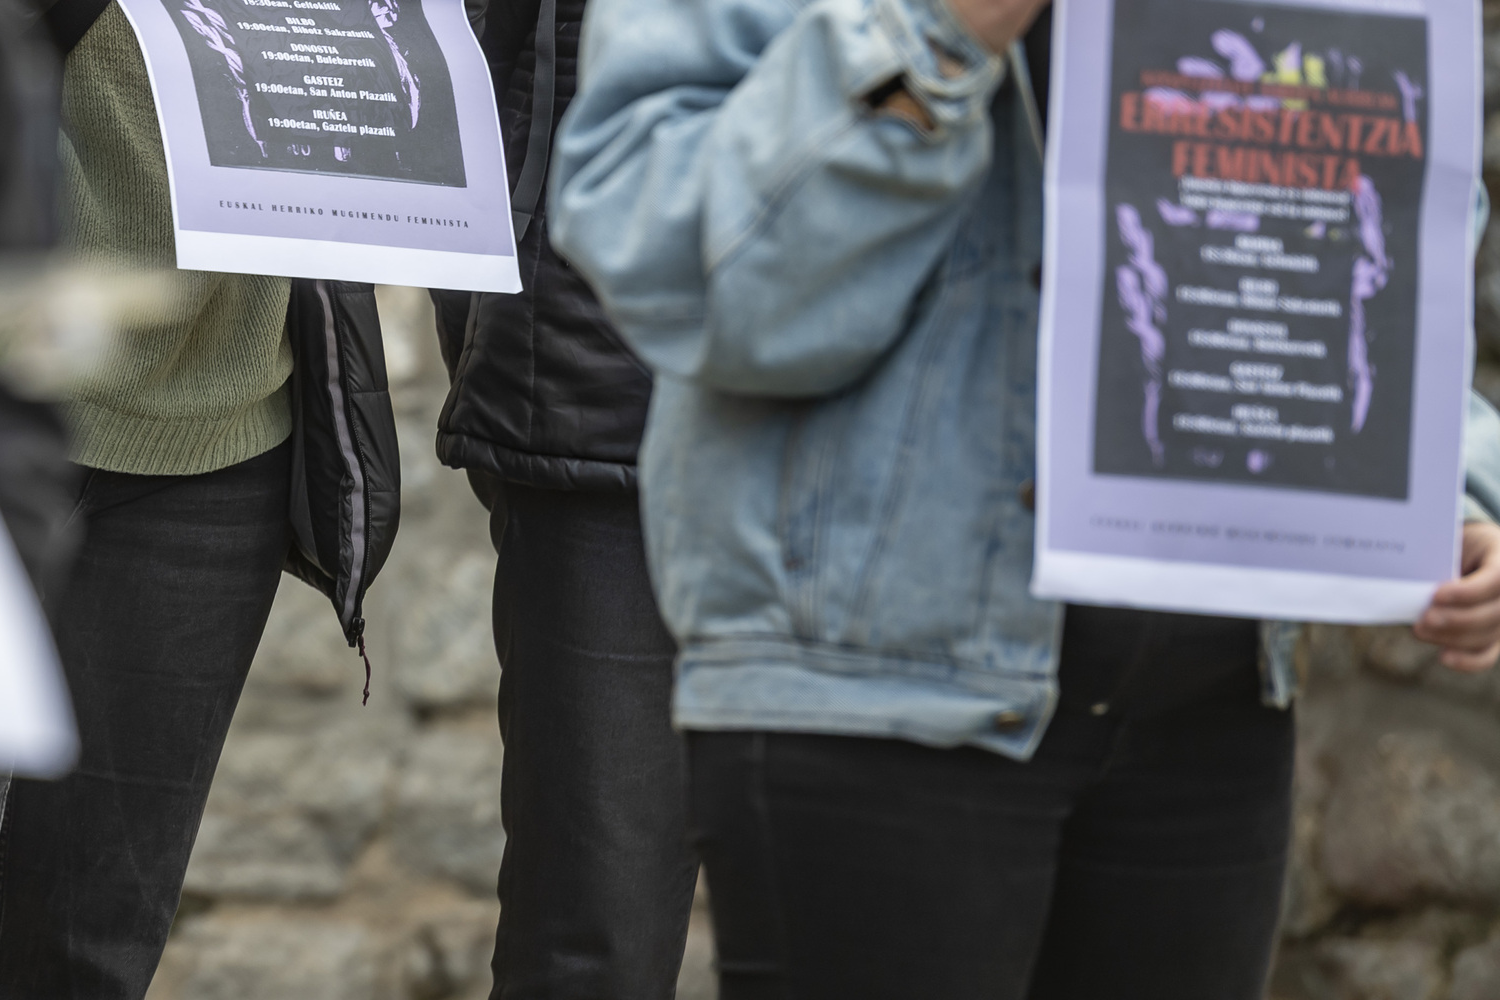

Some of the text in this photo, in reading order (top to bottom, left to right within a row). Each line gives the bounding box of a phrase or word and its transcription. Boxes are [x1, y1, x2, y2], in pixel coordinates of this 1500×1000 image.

[294, 0, 341, 11] Geltokitik
[285, 16, 316, 26] BILBO
[237, 21, 290, 33] 19:00etan,
[293, 25, 323, 36] Bihotz
[290, 43, 339, 55] DONOSTIA
[261, 50, 376, 68] 19:00etan, Bulebarretik
[303, 74, 345, 87] GASTEIZ
[255, 82, 397, 102] 19:00etan, San Anton Plazatik
[313, 109, 348, 121] IRUÑEA
[268, 117, 396, 136] 19:00etan, Gaztelu plazatik
[219, 200, 470, 229] EUSKAL HERRIKO MUGIMENDU FEMINISTA
